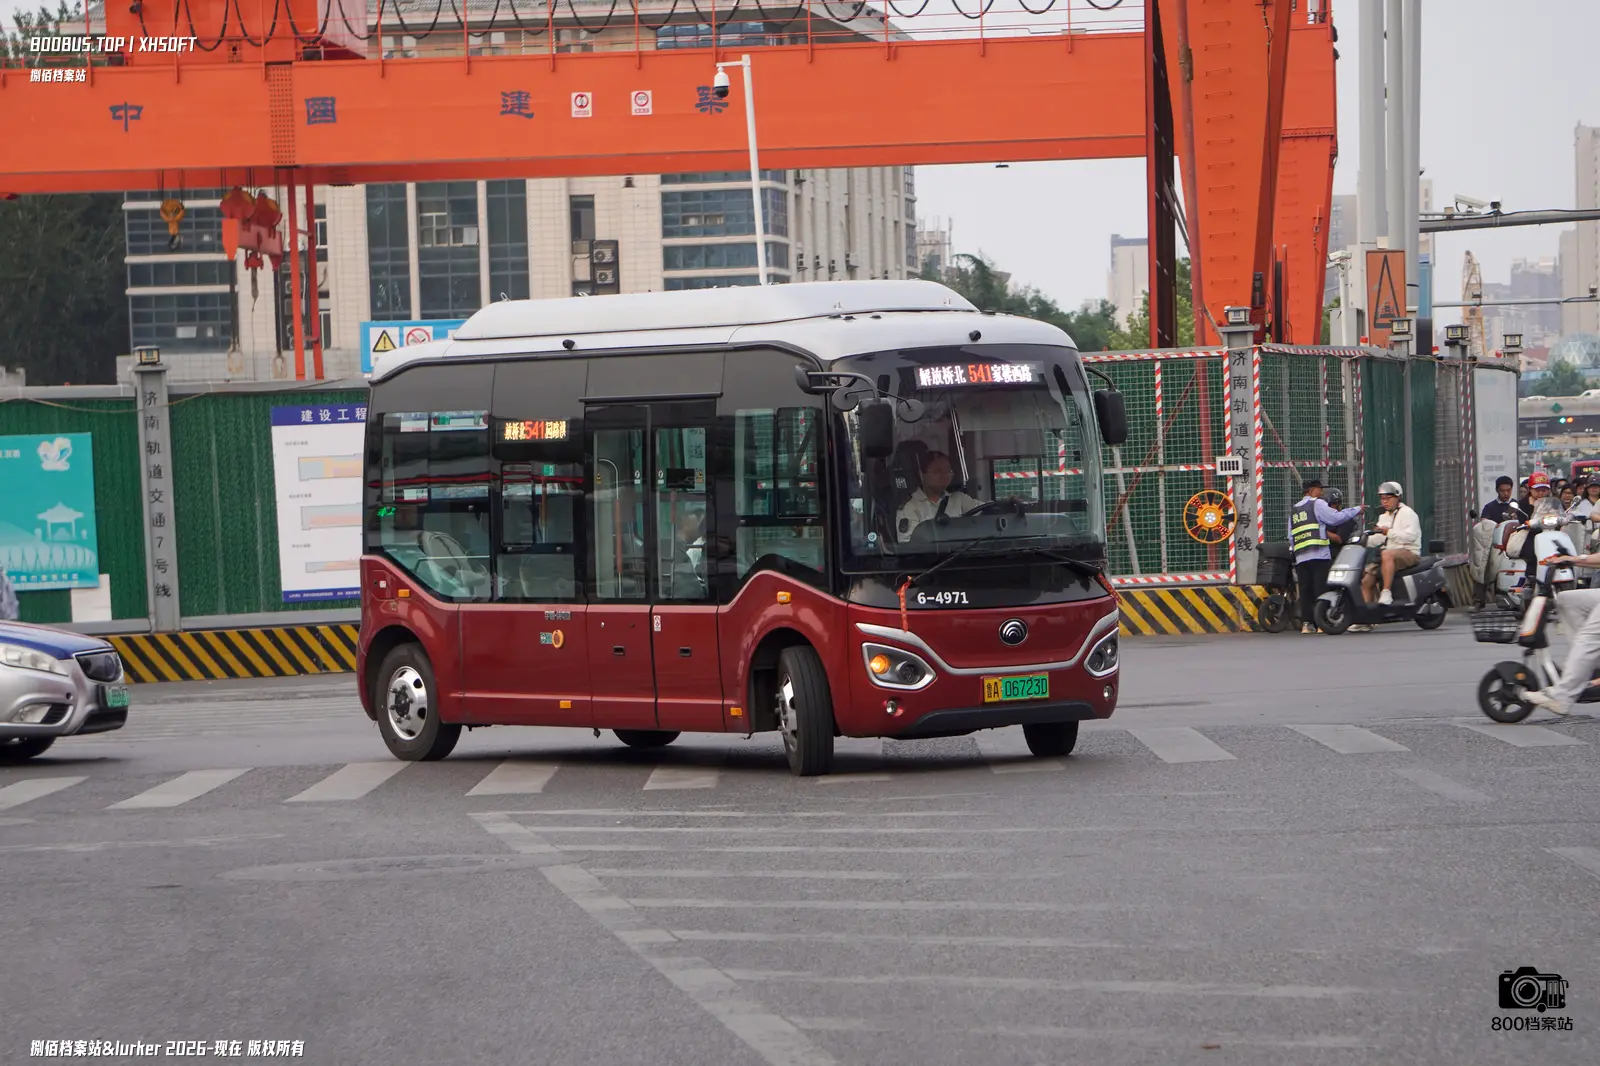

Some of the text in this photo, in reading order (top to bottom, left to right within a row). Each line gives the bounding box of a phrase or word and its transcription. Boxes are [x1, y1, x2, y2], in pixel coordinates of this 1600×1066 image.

[919, 366, 966, 386] 解放桥北
[968, 364, 992, 382] 541
[301, 407, 367, 422] 建设工程
[525, 421, 545, 440] 541
[143, 391, 172, 597] 济南轨道交通7号线
[917, 591, 969, 604] 6-4971
[1005, 678, 1048, 696] 06723D
